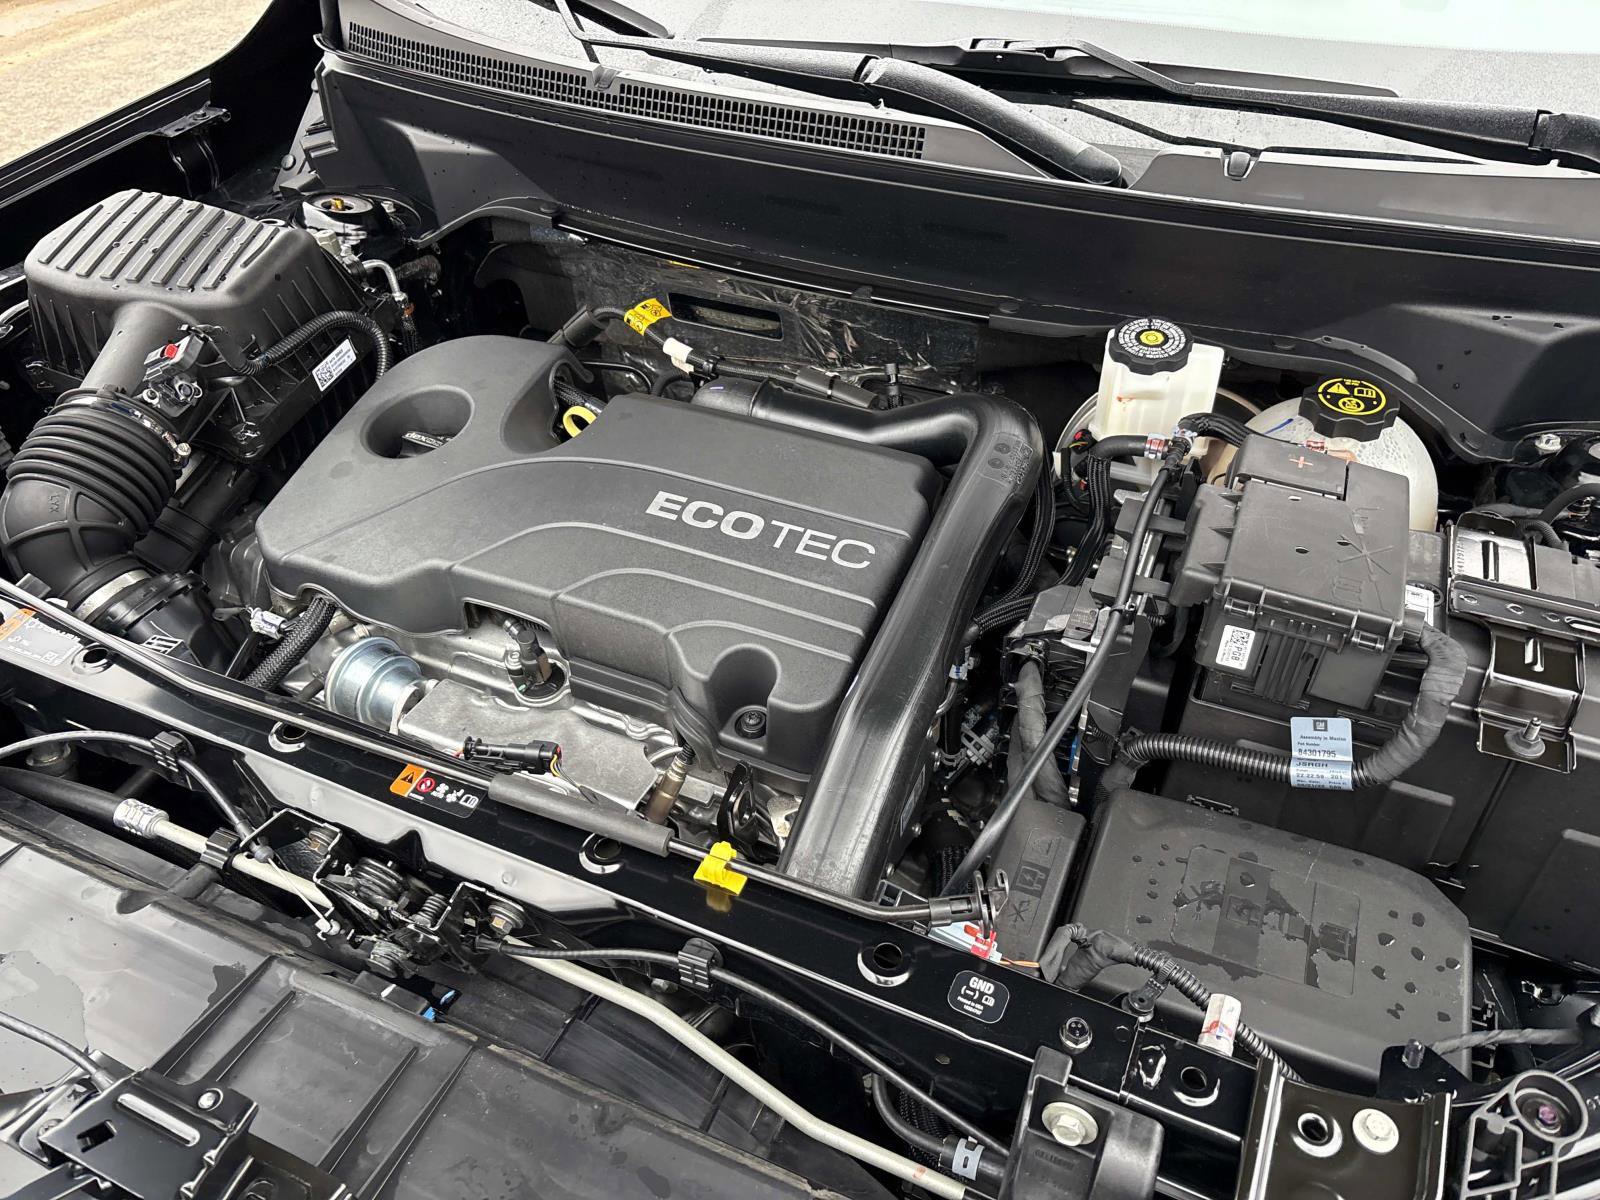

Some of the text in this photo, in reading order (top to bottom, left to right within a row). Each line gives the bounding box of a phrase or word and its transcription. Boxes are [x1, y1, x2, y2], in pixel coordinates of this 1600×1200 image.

[645, 490, 876, 569] ECOTEC
[1298, 748, 1336, 758] 84301795
[969, 976, 995, 995] GND
